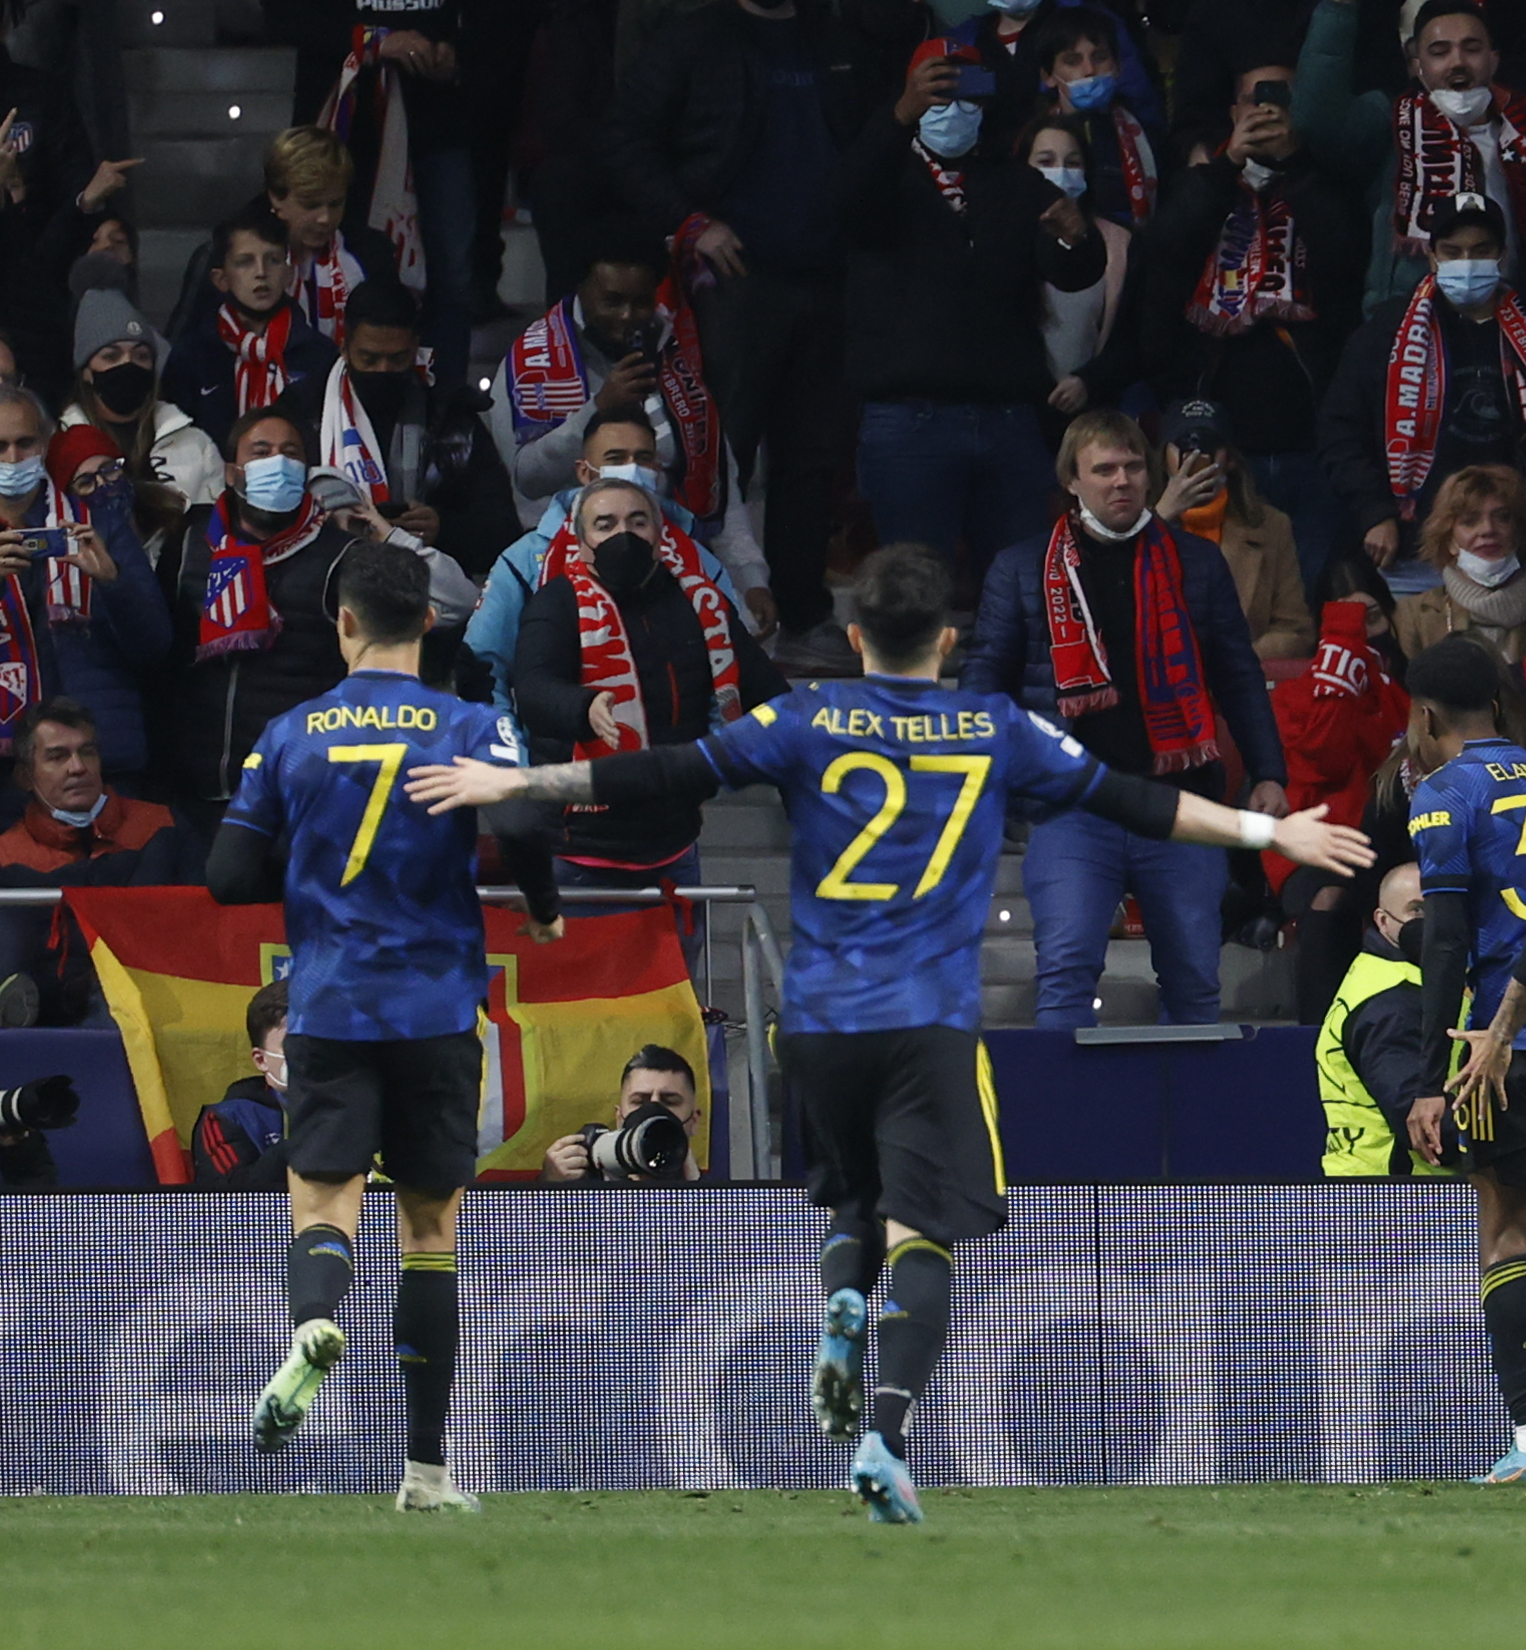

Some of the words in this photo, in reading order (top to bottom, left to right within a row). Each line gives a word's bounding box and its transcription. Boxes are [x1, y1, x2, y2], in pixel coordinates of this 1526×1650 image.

[1395, 298, 1433, 437] A.MADRID
[1050, 586, 1068, 624] 2022
[307, 706, 436, 735] RONALDO
[811, 706, 884, 738] ALEX
[894, 710, 995, 742] TELLES
[328, 743, 408, 887] 7
[815, 752, 993, 902] 27
[1407, 811, 1452, 837] OHLER
